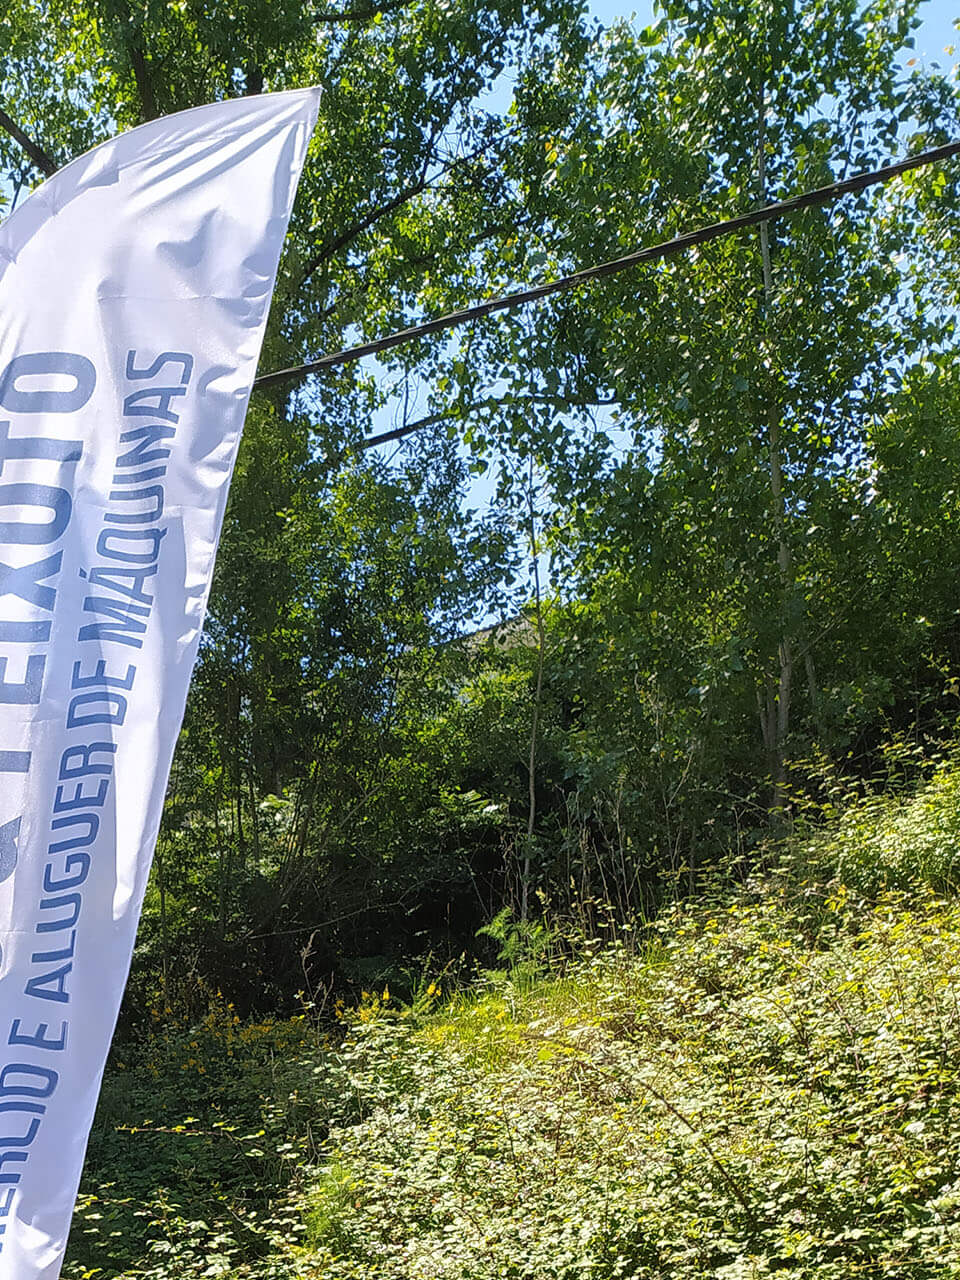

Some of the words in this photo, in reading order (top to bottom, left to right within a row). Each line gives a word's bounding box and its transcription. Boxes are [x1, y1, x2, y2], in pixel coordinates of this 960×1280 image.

[77, 349, 195, 650] MÁQUINAS
[66, 659, 137, 730] DE
[23, 741, 118, 1004] ALUGUER
[7, 1018, 69, 1051] E
